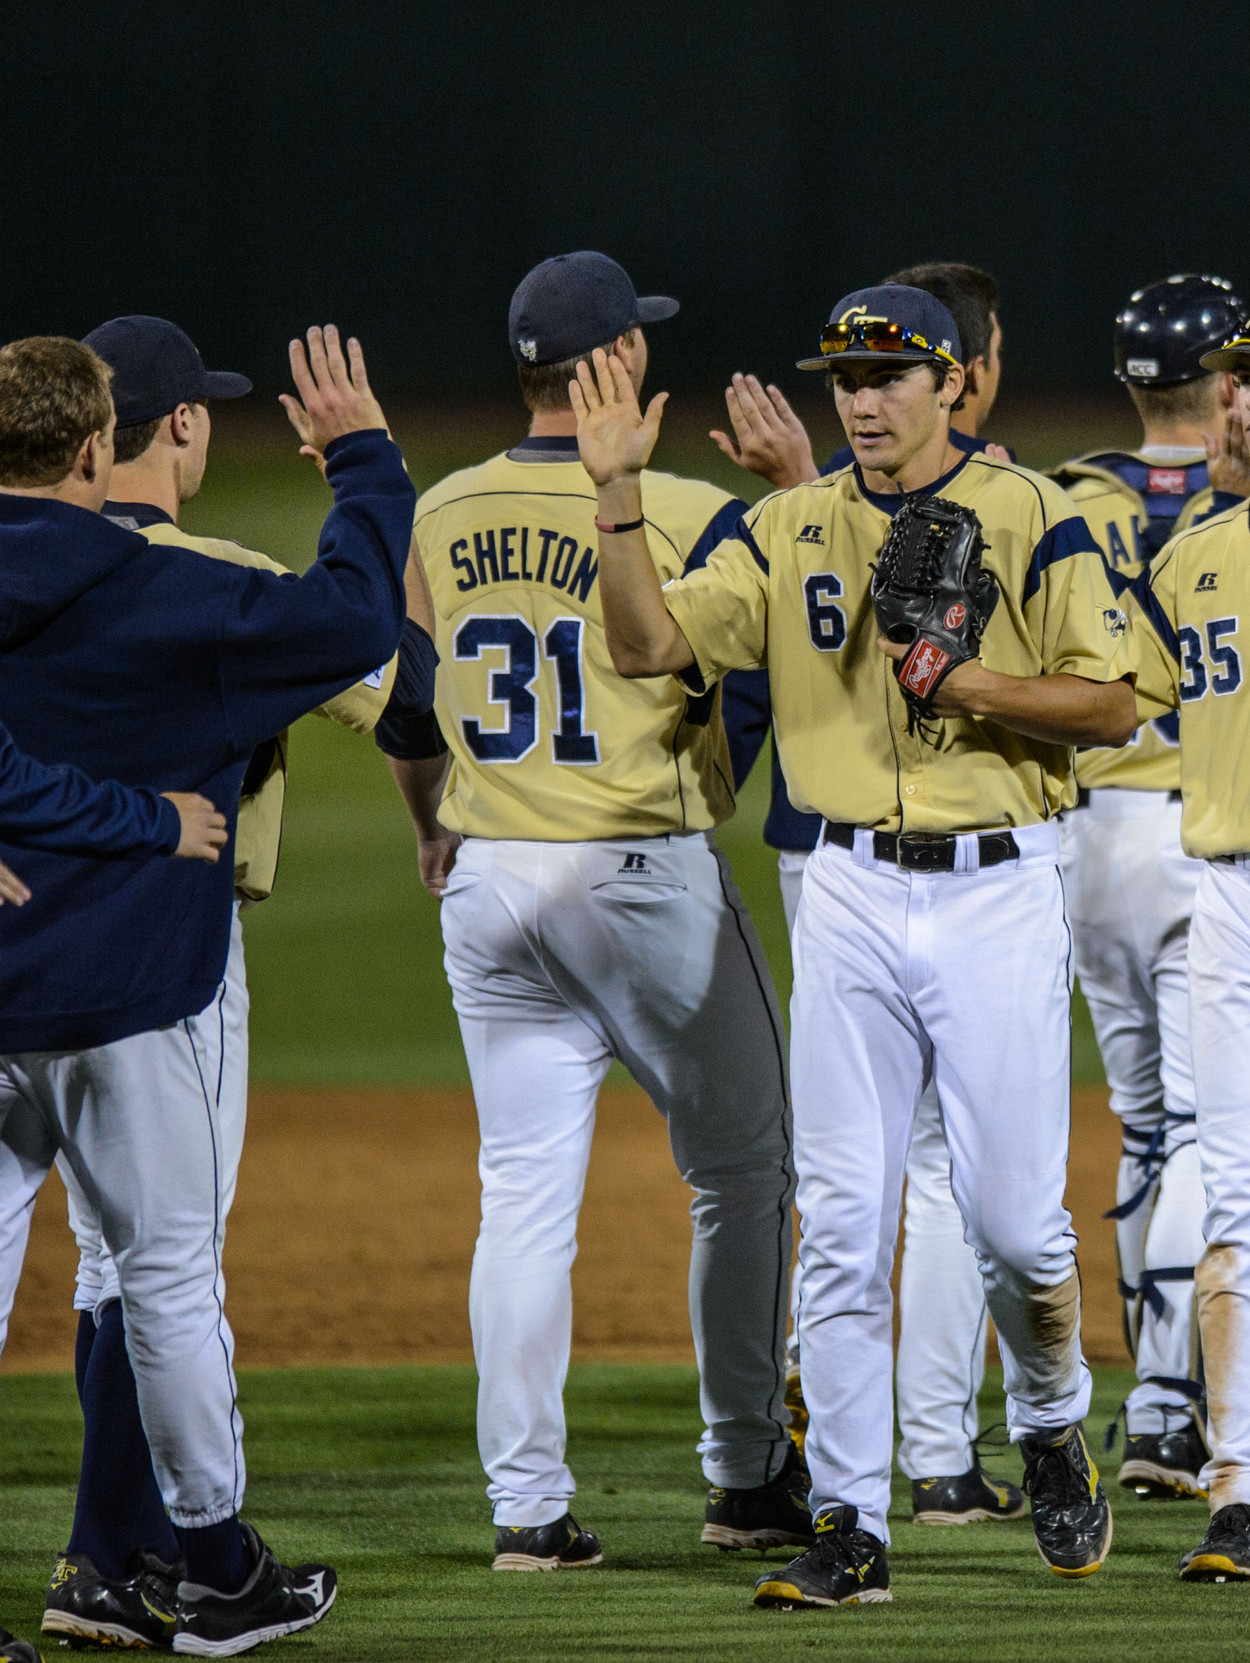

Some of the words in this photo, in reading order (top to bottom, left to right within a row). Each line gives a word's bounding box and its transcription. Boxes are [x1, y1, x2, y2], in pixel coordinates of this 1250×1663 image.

[450, 527, 598, 603] SHELTON
[803, 572, 847, 652] 6
[453, 614, 601, 765] 31
[909, 647, 933, 688] Rawlings
[1178, 616, 1243, 703] 35
